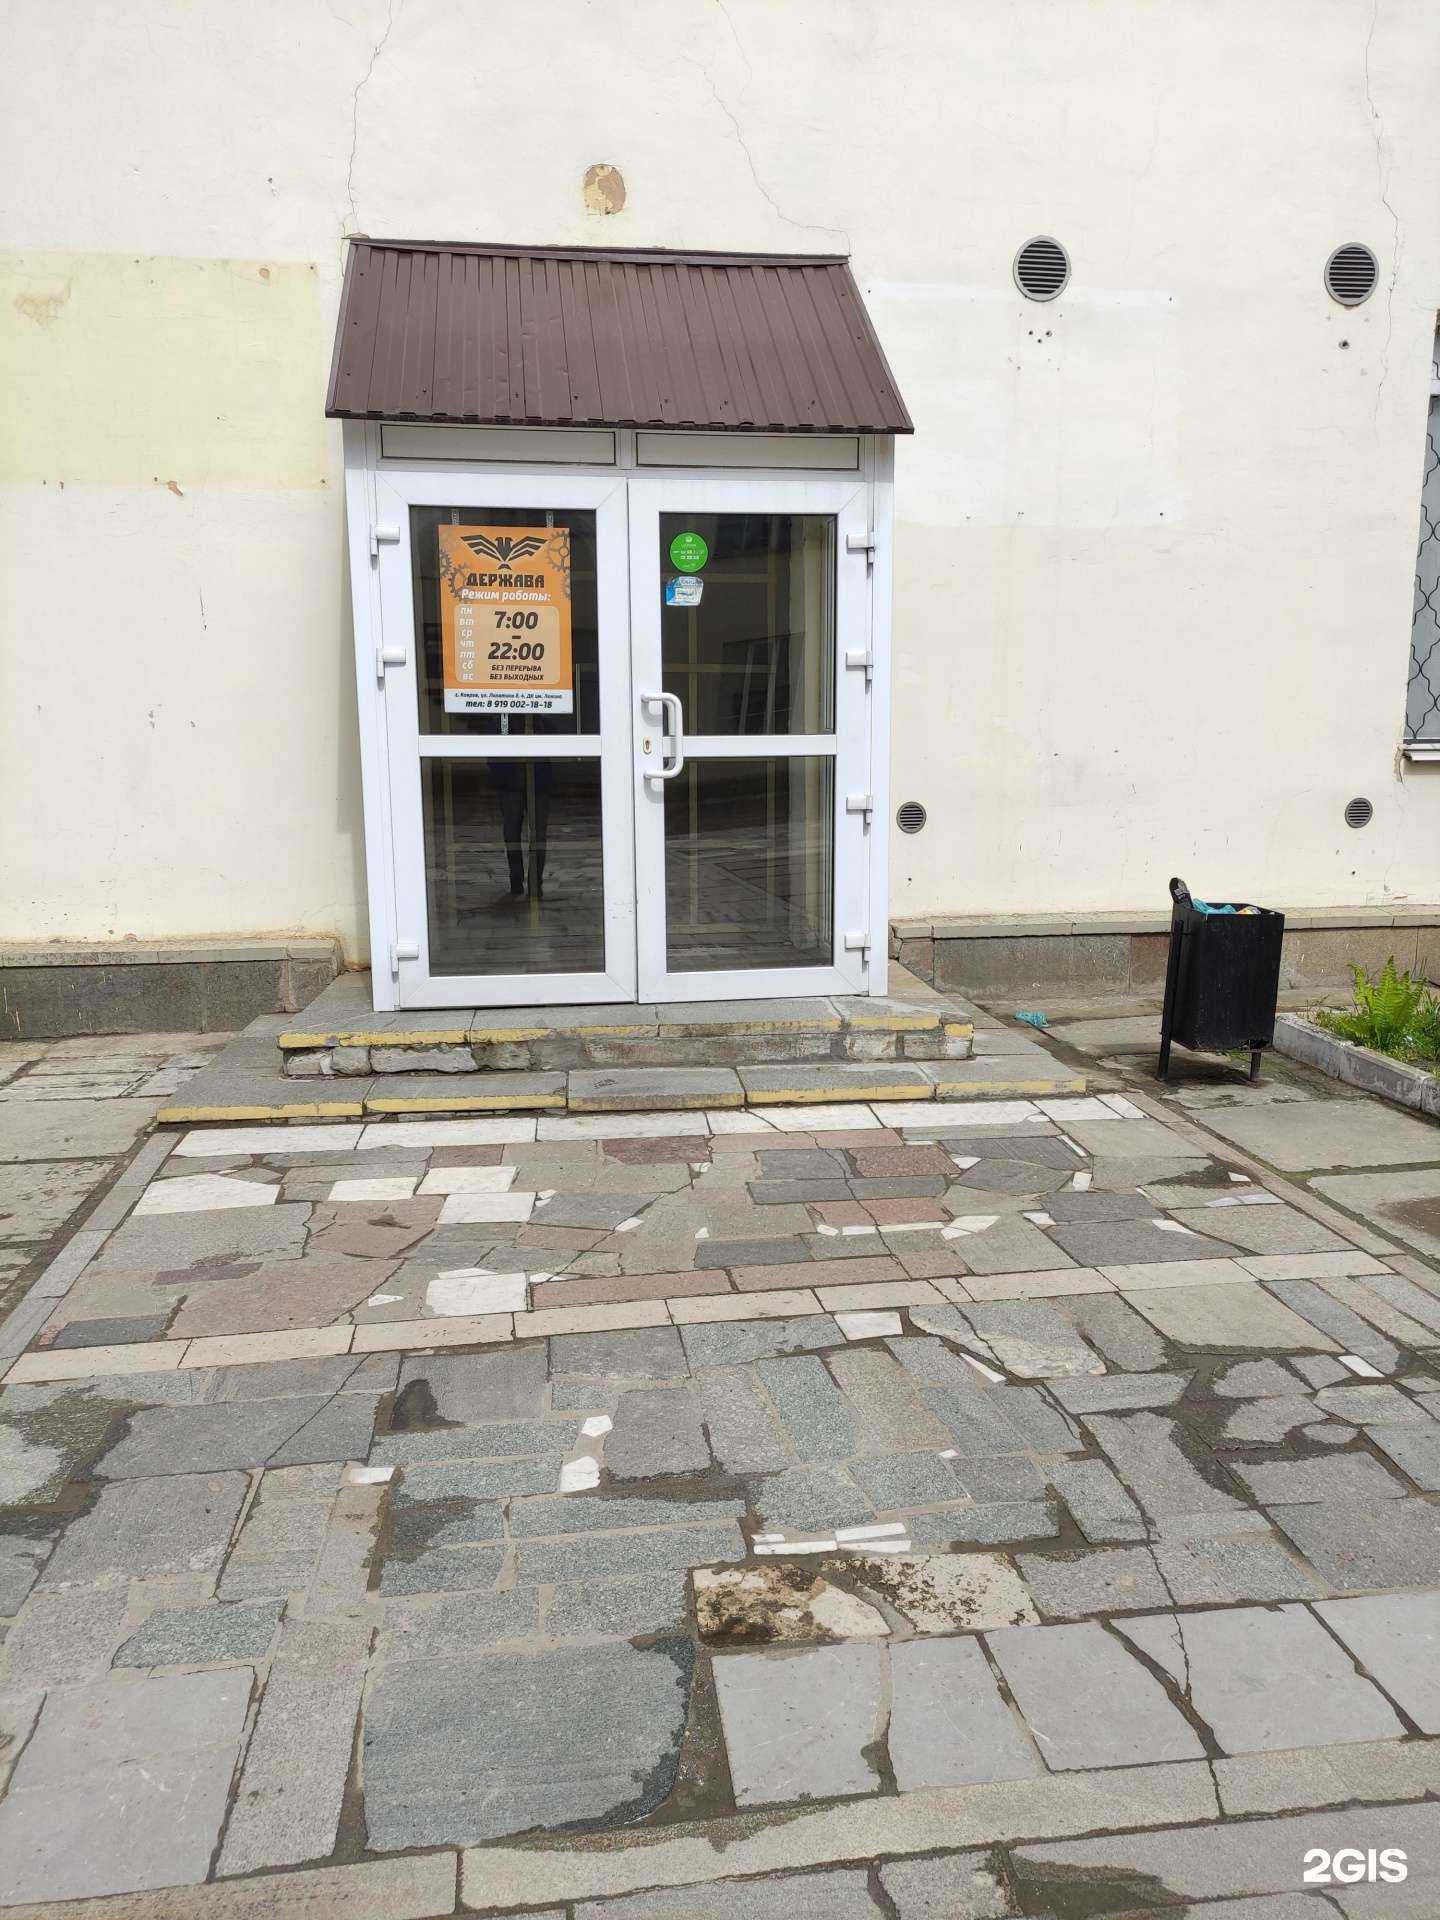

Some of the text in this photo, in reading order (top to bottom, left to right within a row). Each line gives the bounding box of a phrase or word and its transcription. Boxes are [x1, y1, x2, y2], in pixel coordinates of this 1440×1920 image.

[466, 573, 545, 588] ДЕРЖАВА
[461, 588, 551, 601] Режим работы:
[494, 610, 539, 630] 7:00
[488, 642, 545, 661] 22:00
[491, 664, 542, 673] БЕЗ ПЕРЕРЫВА
[510, 701, 553, 709] 002-18-18
